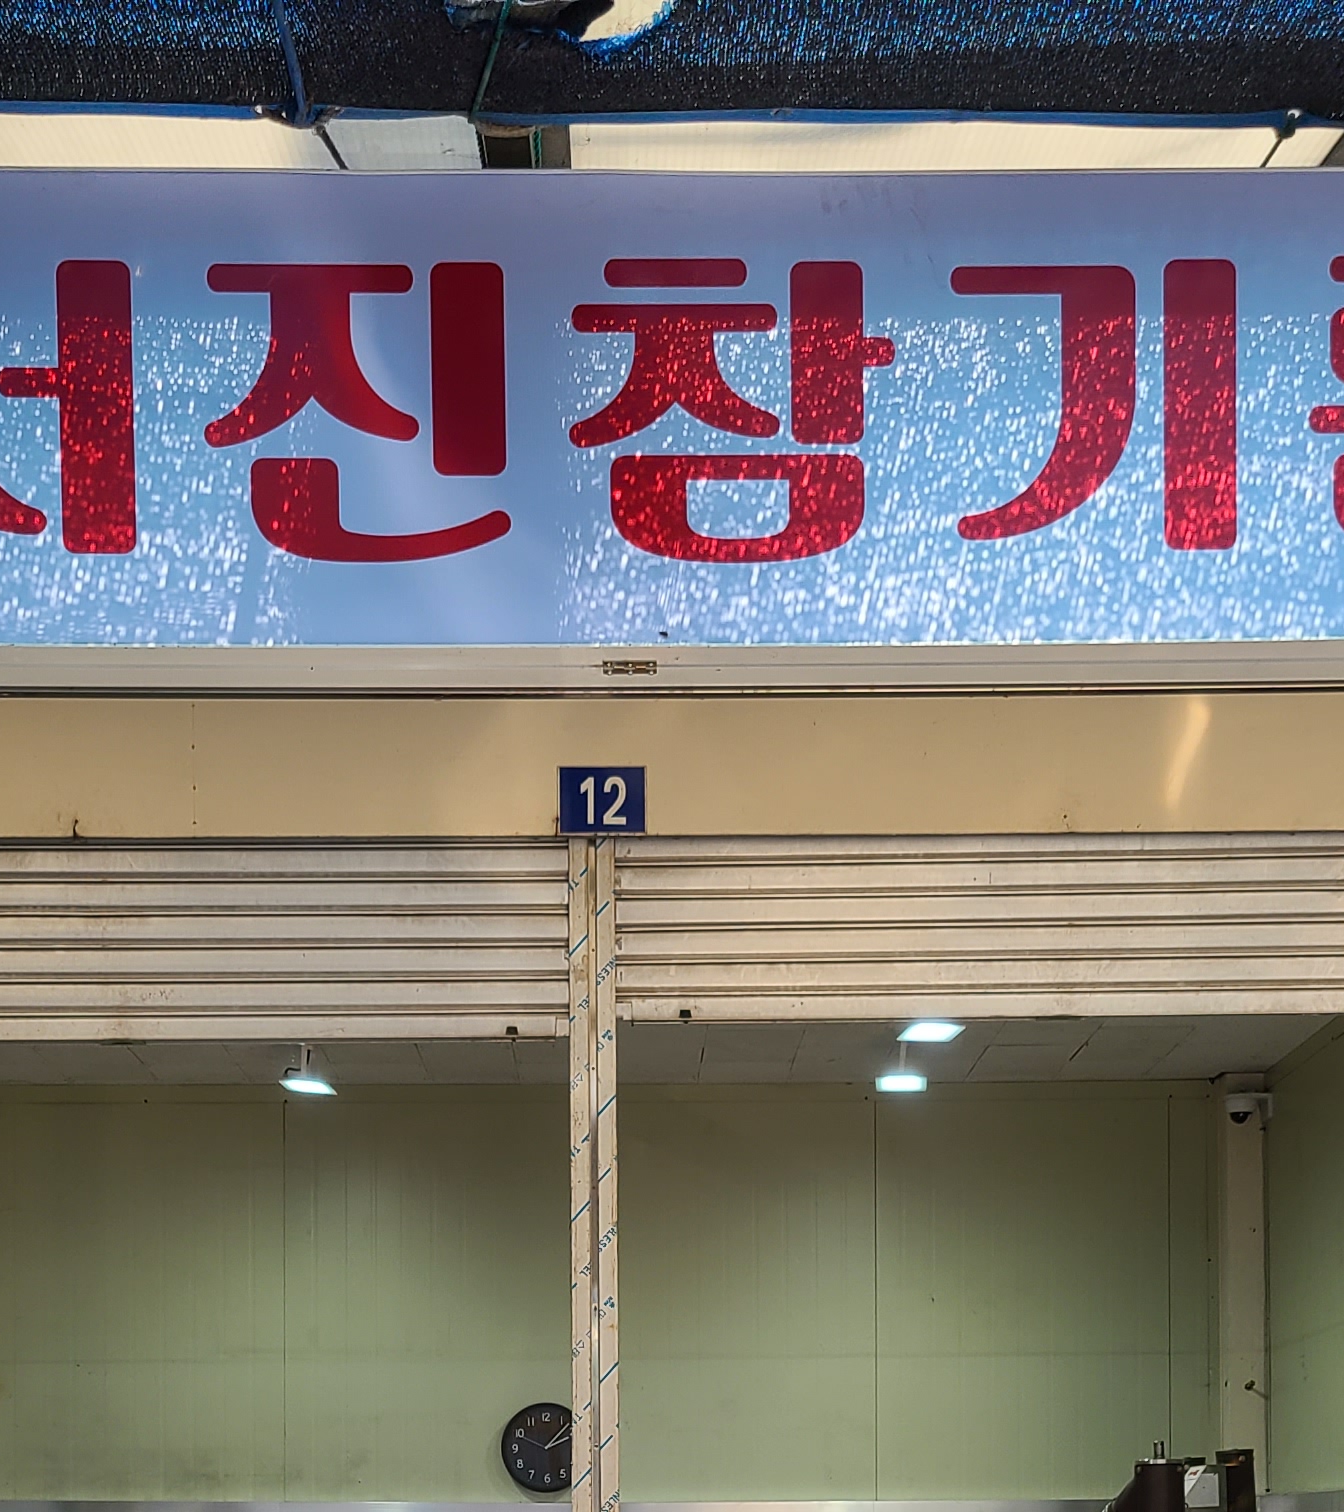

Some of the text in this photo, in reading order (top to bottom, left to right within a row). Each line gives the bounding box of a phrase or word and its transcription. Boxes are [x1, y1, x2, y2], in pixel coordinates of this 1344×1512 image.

[579, 775, 627, 826] 12
[527, 1416, 535, 1427] 11
[542, 1412, 551, 1422] 12
[560, 1416, 564, 1426] 1
[515, 1428, 525, 1439] 10
[511, 1443, 519, 1454] 9
[516, 1459, 524, 1469] 8
[528, 1469, 535, 1480] 7
[544, 1473, 551, 1484] 6
[559, 1468, 567, 1478] 5
